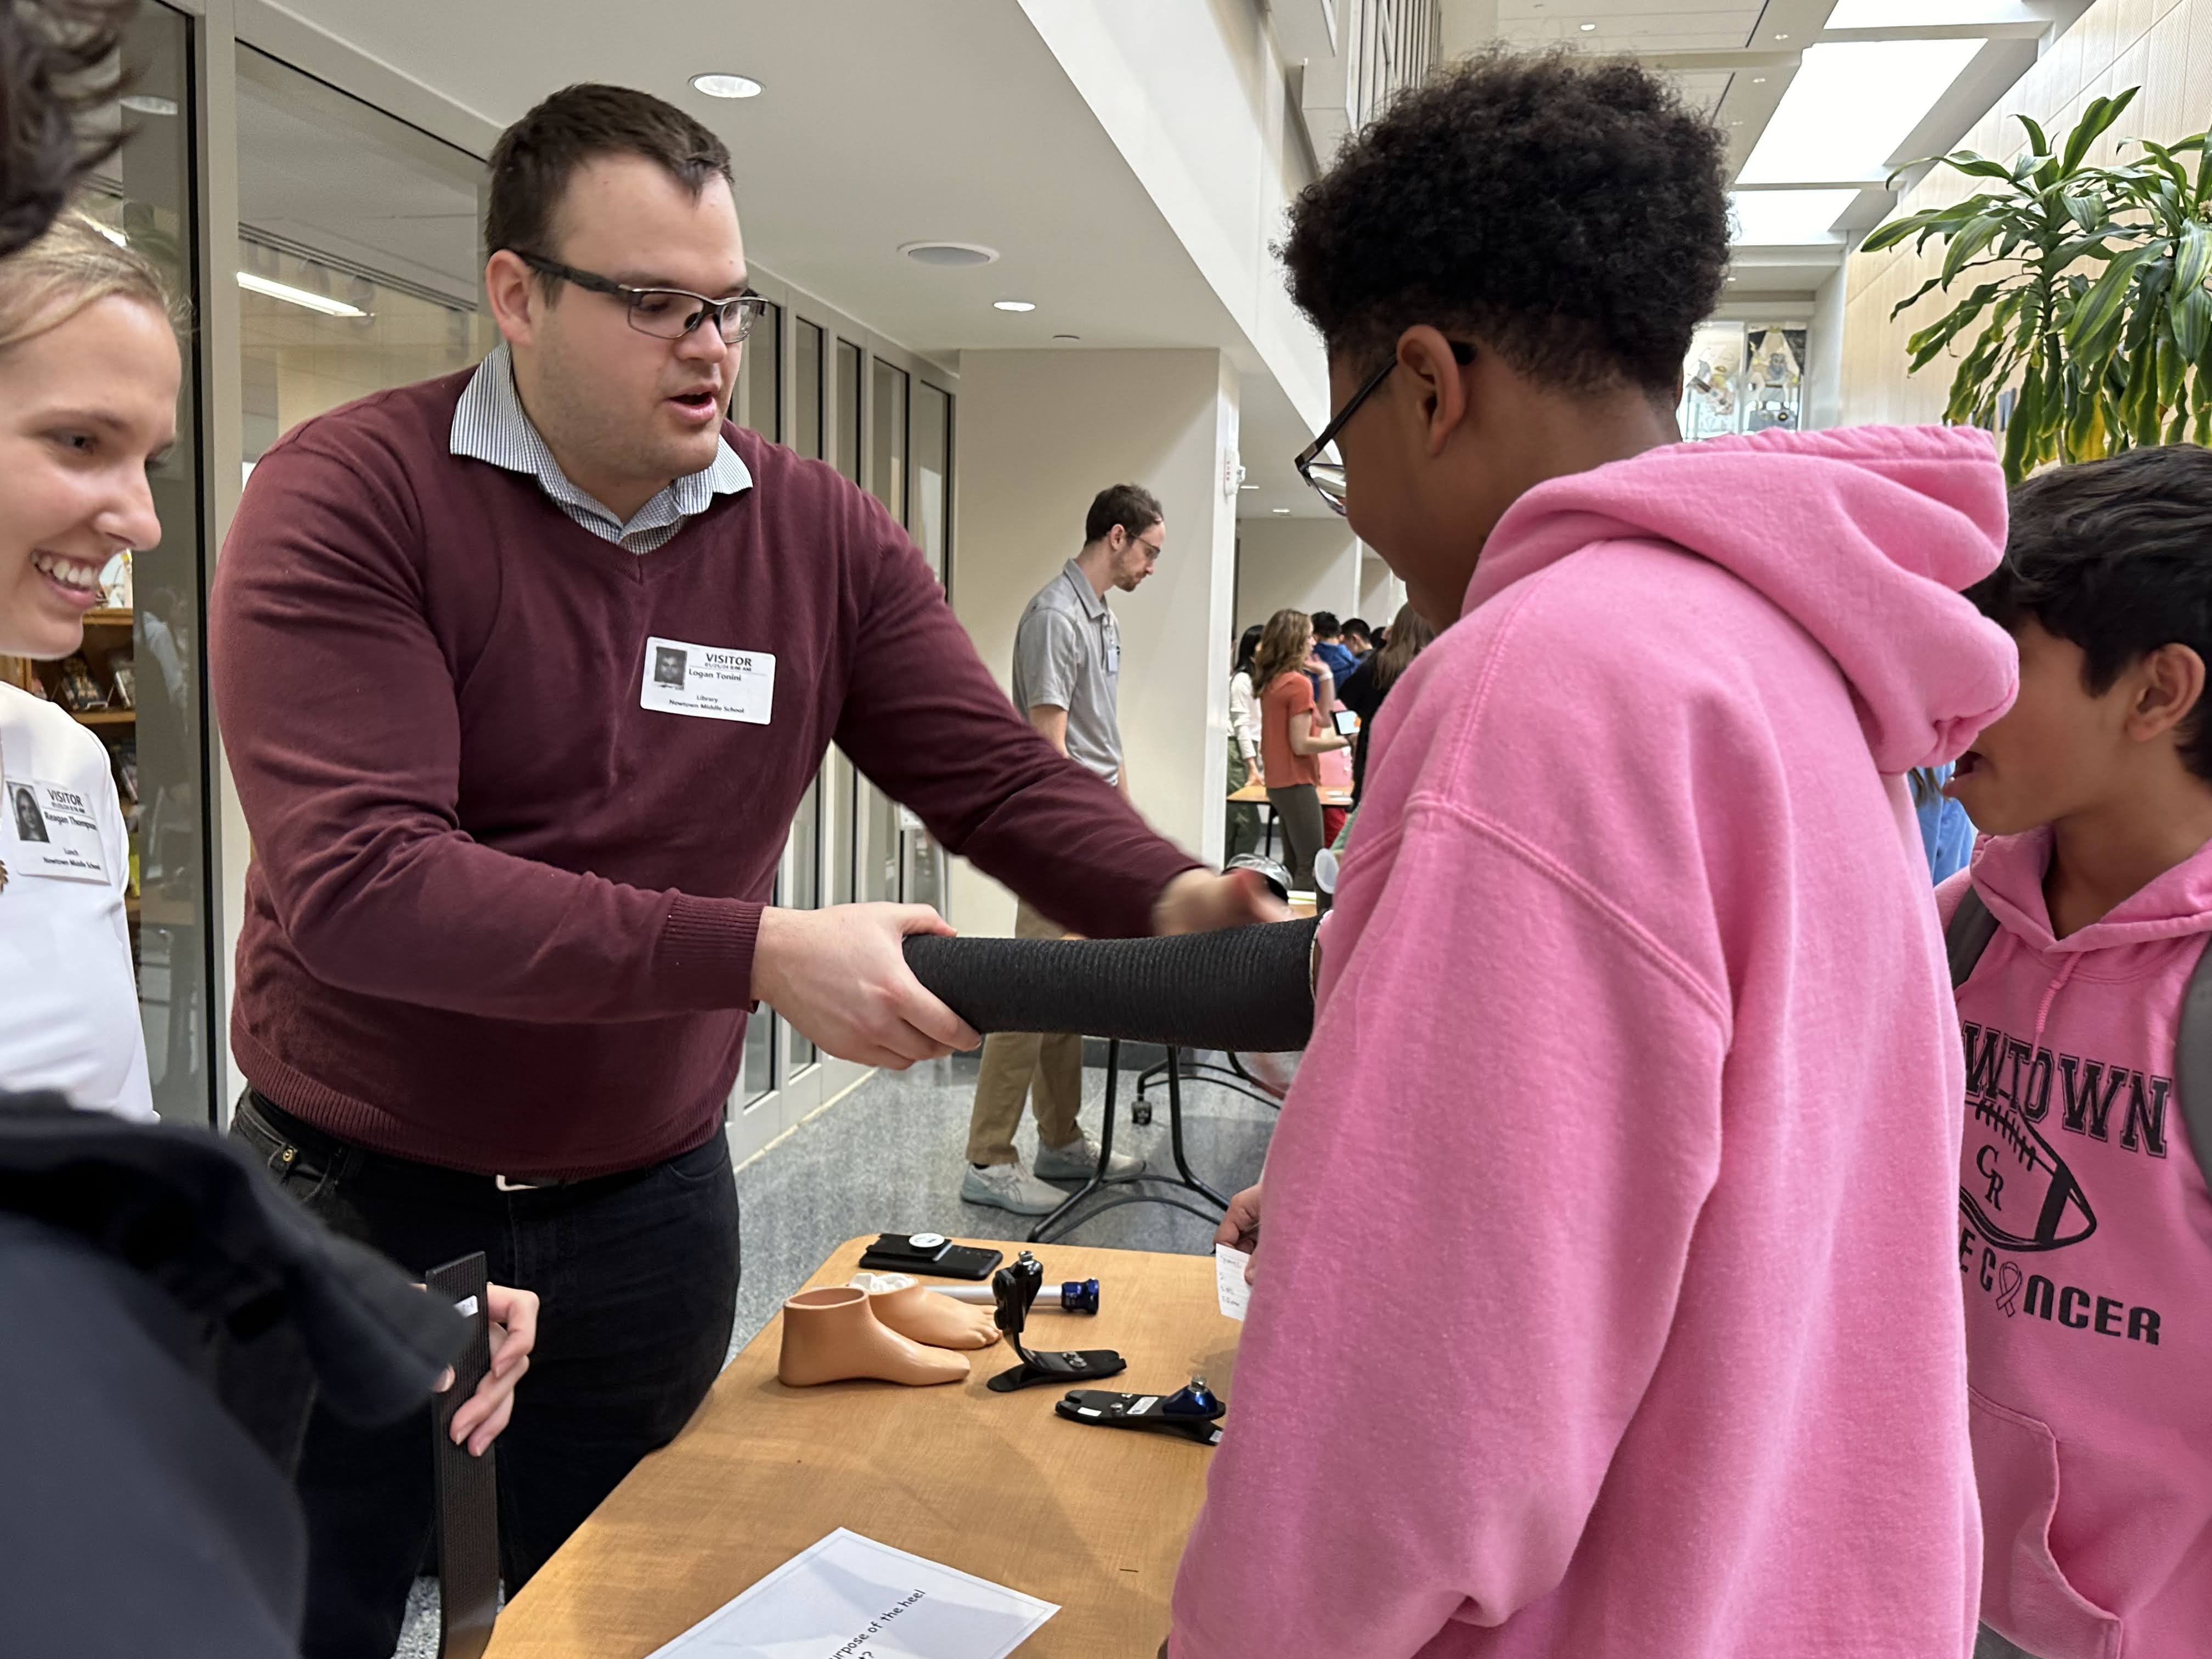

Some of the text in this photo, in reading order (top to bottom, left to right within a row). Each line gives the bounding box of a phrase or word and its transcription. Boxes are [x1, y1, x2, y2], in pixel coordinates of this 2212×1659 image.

[706, 653, 752, 667] VISITOR
[689, 668, 741, 681] Logan Tonini
[669, 699, 699, 708] Newtown
[696, 694, 718, 703] Library
[47, 788, 84, 808] VISITOR
[867, 1621, 883, 1633] of
[879, 1607, 904, 1622] the
[897, 1589, 926, 1607] heel
